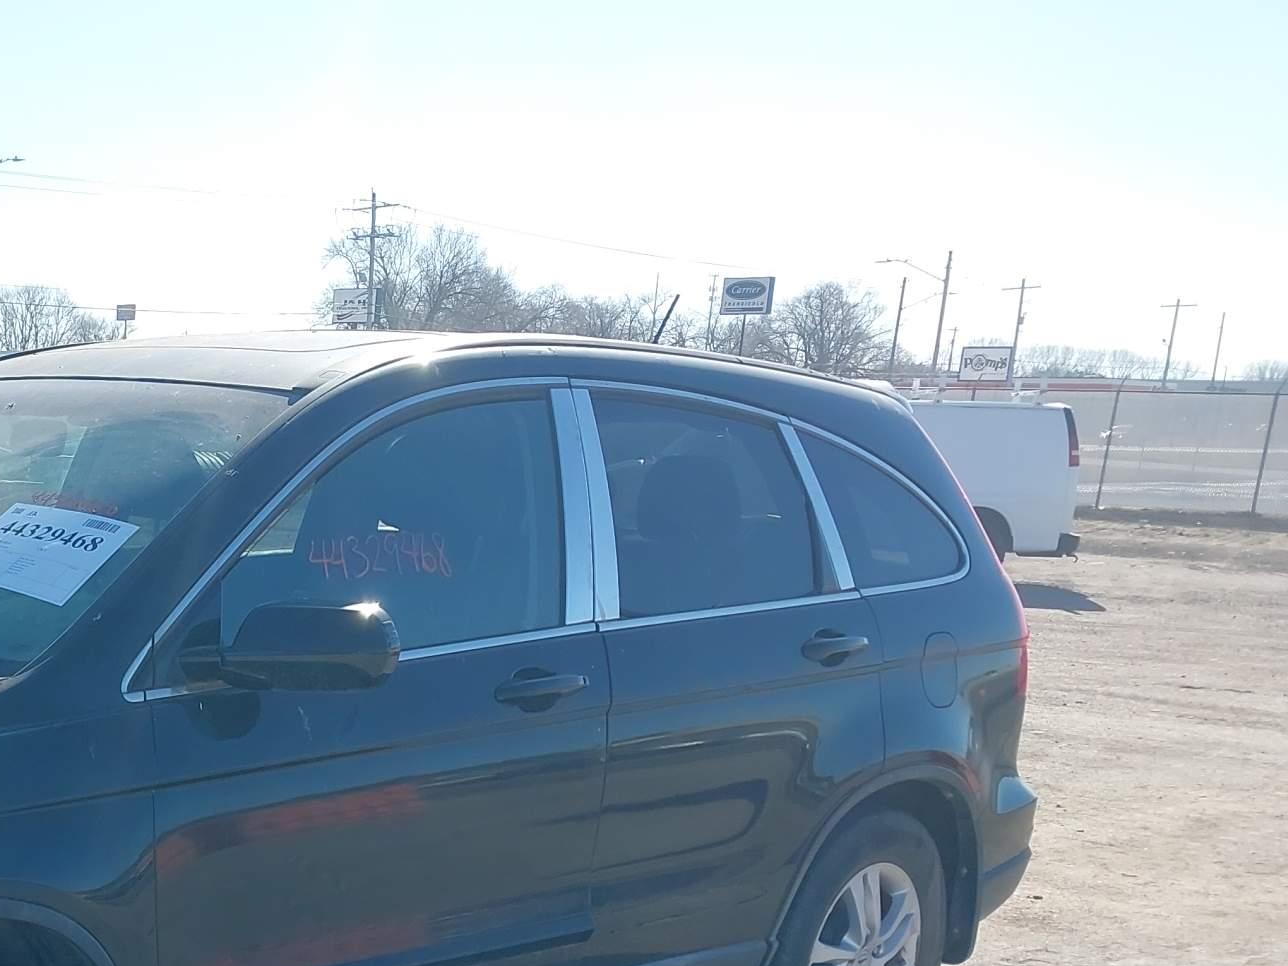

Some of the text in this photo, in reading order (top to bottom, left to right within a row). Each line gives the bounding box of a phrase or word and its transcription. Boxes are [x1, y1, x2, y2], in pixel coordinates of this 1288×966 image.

[731, 285, 762, 295] Carrier
[0, 520, 104, 552] 44329468
[308, 530, 453, 580] 44329468
